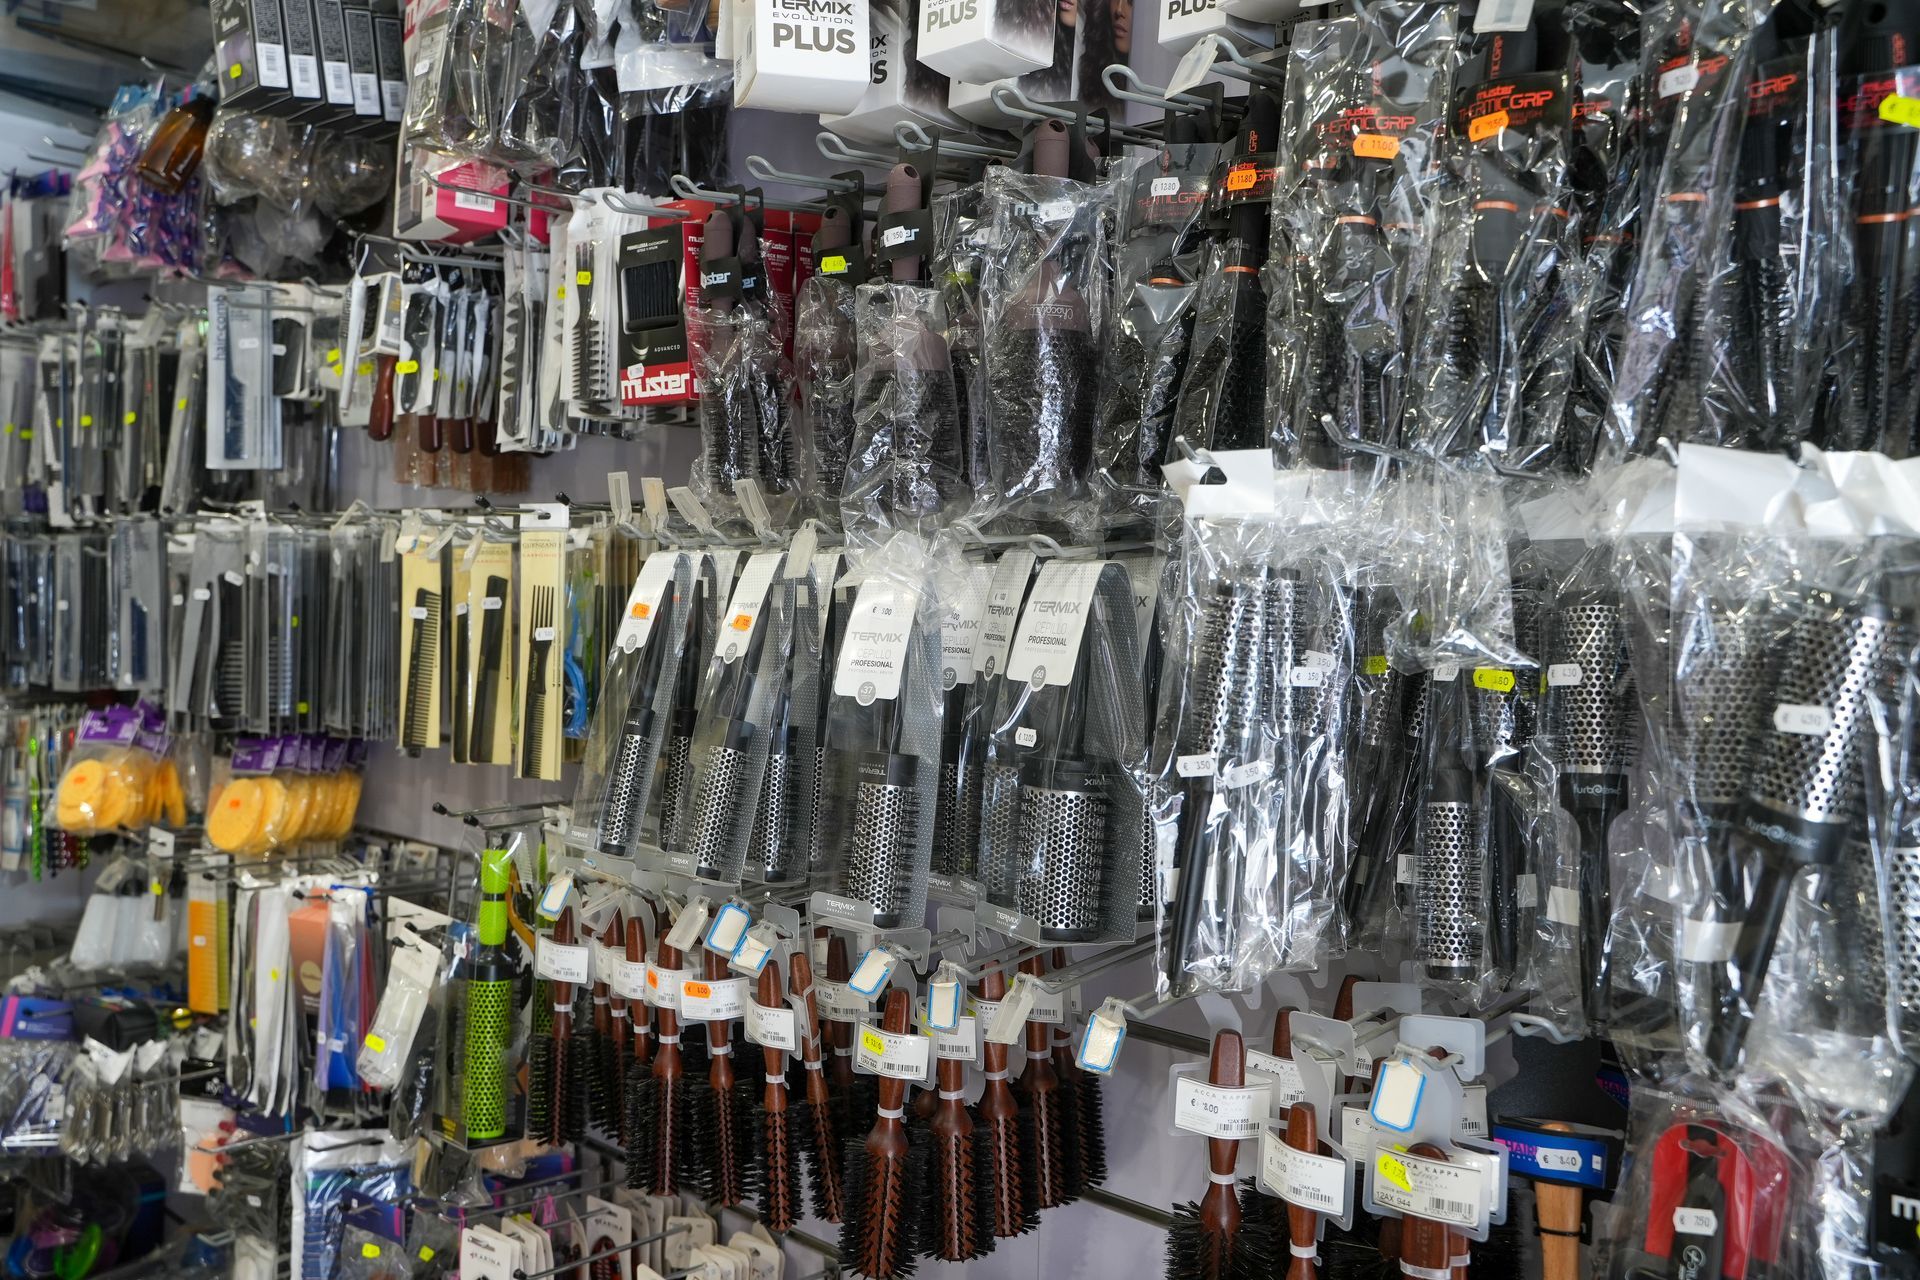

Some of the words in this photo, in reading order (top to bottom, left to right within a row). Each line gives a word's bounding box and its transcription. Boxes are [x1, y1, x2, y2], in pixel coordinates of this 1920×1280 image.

[771, 0, 853, 16] TERMIX
[773, 12, 853, 24] EVOLUTION
[927, 0, 978, 32] PLUS
[773, 23, 855, 54] PLUS
[1476, 85, 1516, 99] muster
[1749, 74, 1798, 98] GRIP
[654, 344, 681, 352] ADVANCED
[620, 371, 690, 399] muster
[988, 605, 1015, 617] TERMIX
[1033, 601, 1083, 616] TERMIX
[1035, 621, 1068, 634] CEPILLO
[851, 631, 903, 645] TERMIX
[1028, 635, 1067, 646] PROFESIONAL
[858, 648, 892, 659] CEPILLO
[850, 660, 894, 669] PROFESIONAL
[1296, 673, 1301, 681] €
[1478, 675, 1482, 683] €
[1183, 763, 1188, 771] €
[960, 880, 977, 891] TERMIX
[826, 900, 856, 912] TERMIX
[996, 911, 1019, 924] TERMIX
[1194, 1088, 1217, 1098] ACCA
[1191, 1098, 1196, 1106] €
[1356, 1117, 1361, 1125] €
[1292, 1157, 1323, 1169] KAPPA
[1543, 1154, 1549, 1164] €
[1425, 1166, 1459, 1178] KAPPA
[1376, 1190, 1394, 1202] 12AX
[1396, 1198, 1411, 1207] 944
